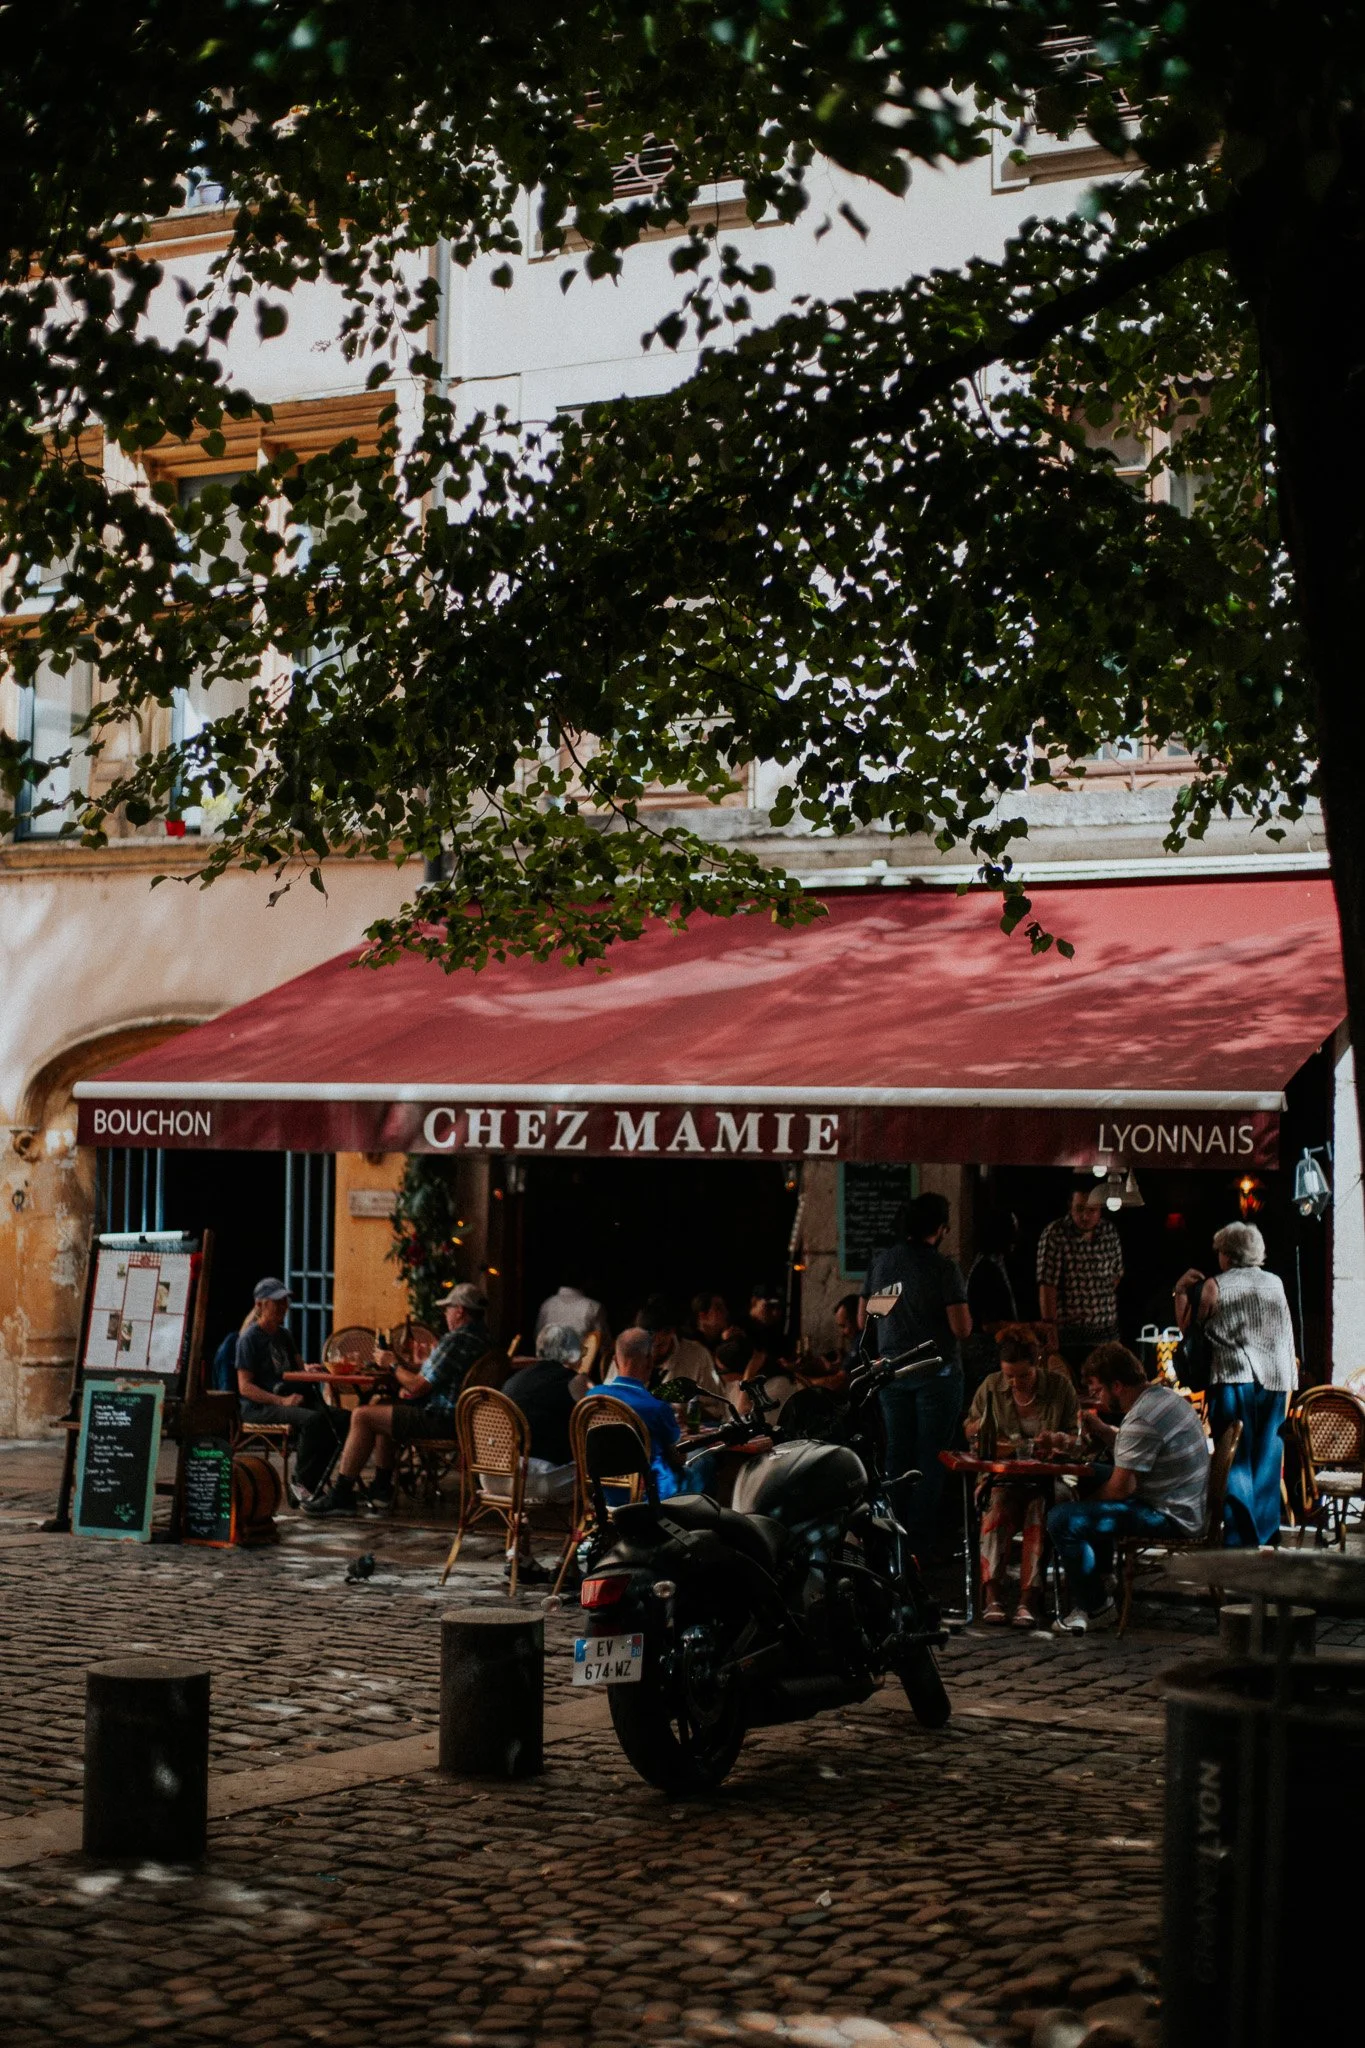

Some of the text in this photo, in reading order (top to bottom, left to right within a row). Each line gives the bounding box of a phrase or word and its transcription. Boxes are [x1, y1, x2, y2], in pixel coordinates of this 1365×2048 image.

[93, 1108, 211, 1137] BOUCHON
[422, 1107, 840, 1156] CHEZ MAMIE
[1098, 1123, 1255, 1155] LYONNAIS
[596, 1640, 613, 1657] EV
[1199, 1760, 1222, 1861] LYON
